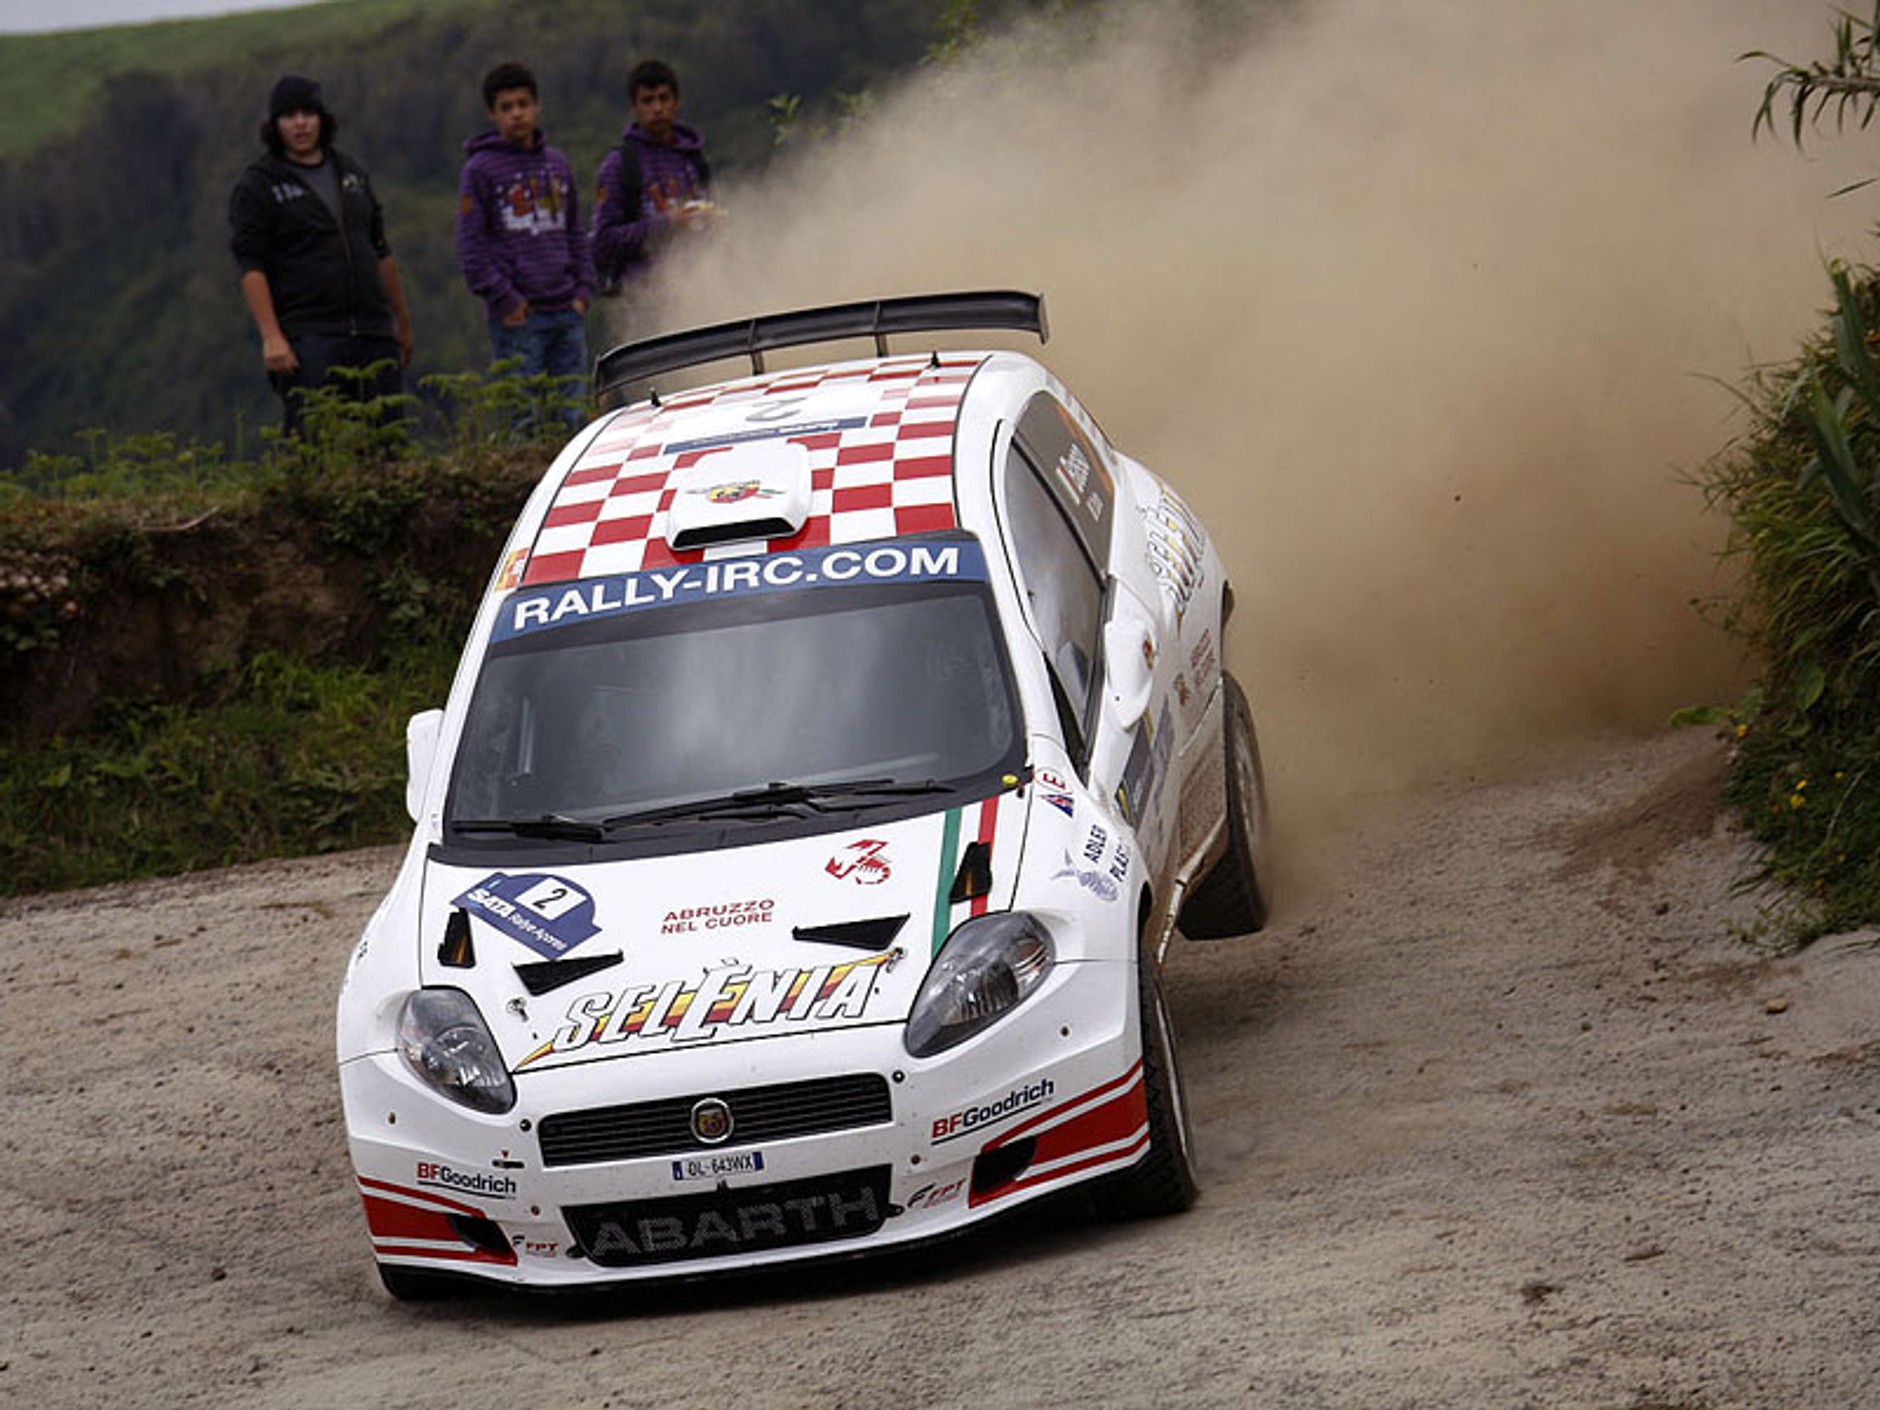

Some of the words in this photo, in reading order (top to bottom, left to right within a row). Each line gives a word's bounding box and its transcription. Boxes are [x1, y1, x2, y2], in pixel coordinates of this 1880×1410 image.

[514, 547, 961, 631] RALLY-IRC.COM
[1083, 824, 1107, 865] ADLER
[466, 888, 517, 919] SATA
[532, 888, 568, 910] 2
[663, 898, 775, 922] ABRUZZO
[661, 920, 698, 934] NEL
[705, 912, 773, 929] CUORE
[552, 958, 882, 1053] SELÈNIA
[931, 1078, 1055, 1139] BFGoodrich
[417, 1162, 517, 1193] BFGoodrich
[594, 1186, 879, 1257] ABARTH
